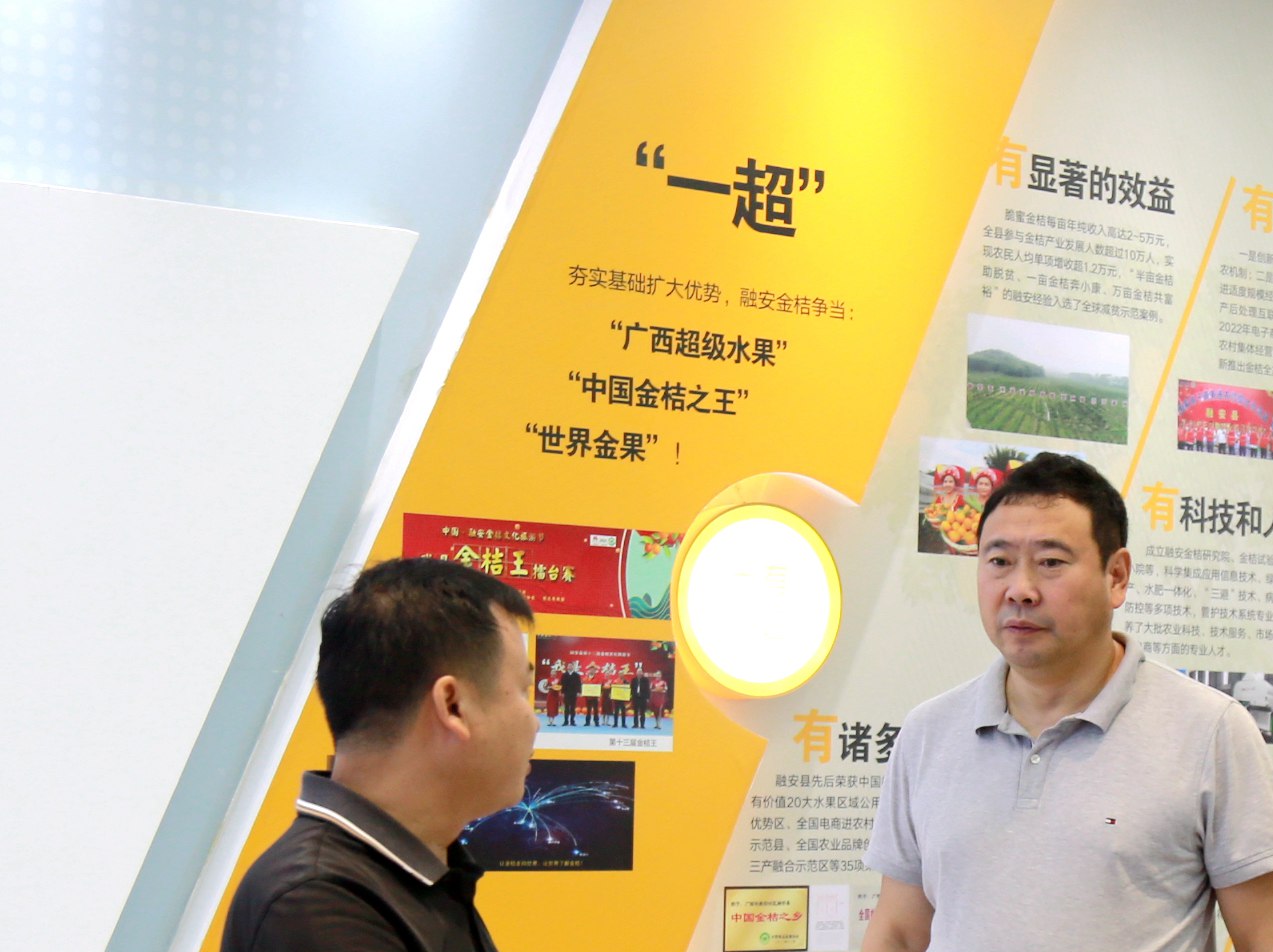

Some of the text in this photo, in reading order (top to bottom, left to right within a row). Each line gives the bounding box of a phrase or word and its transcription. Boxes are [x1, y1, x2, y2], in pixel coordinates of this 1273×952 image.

[635, 141, 825, 237] “一超”
[996, 136, 1176, 215] 有显著的效益
[568, 264, 854, 321] 夯实基础扩大优势，融安金桔争当：
[610, 320, 787, 367] “广西超级水果”
[568, 371, 749, 416] “中国金桔之王”
[1139, 642, 1231, 657] 商等方面的专业人才。
[776, 774, 886, 788] 融安县先后荣获中国
